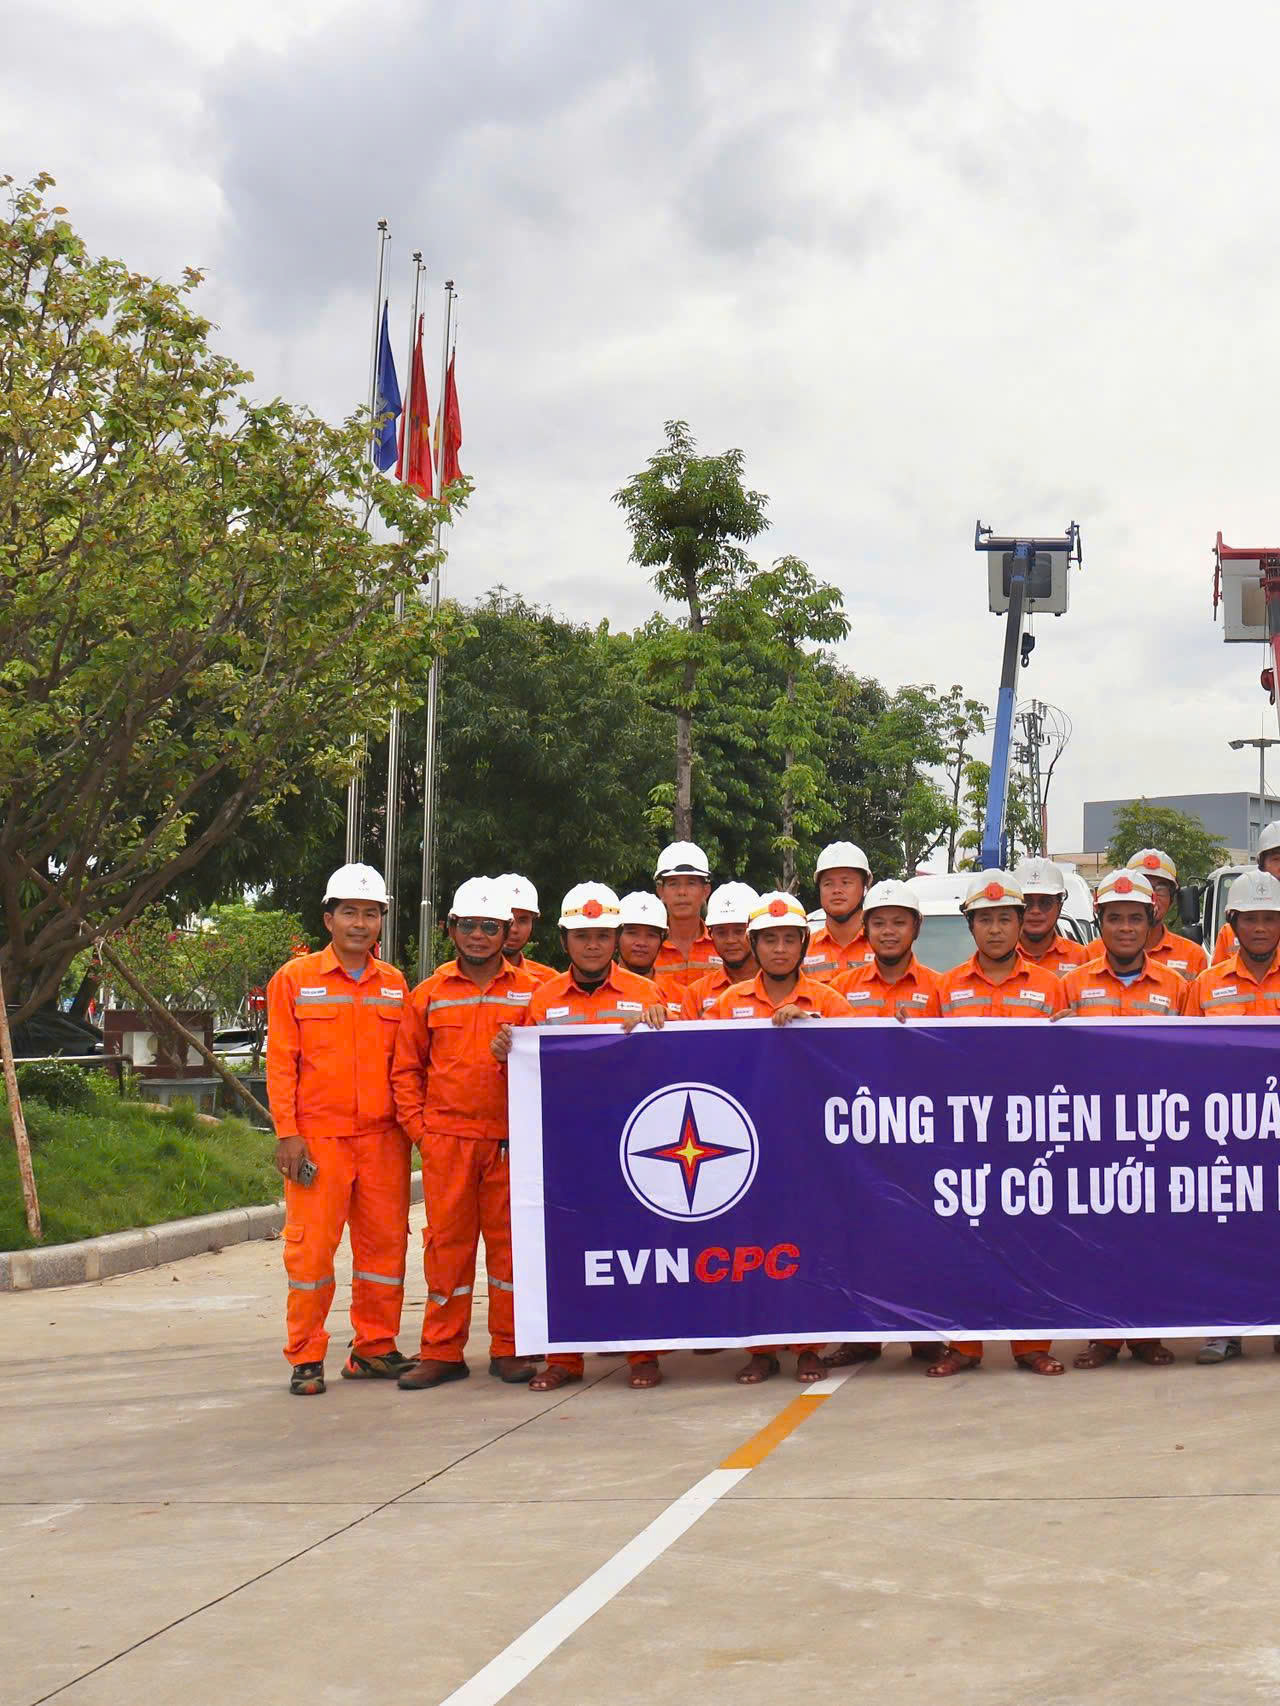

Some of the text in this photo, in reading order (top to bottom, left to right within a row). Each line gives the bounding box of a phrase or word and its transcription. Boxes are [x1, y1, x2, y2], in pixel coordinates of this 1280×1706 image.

[824, 1086, 935, 1145] CÔNG
[947, 1095, 994, 1143] TY
[1005, 1084, 1101, 1152] ĐIỆN
[1115, 1088, 1190, 1152] LỰC
[933, 1163, 992, 1227] SỰ
[1000, 1150, 1055, 1216] CỐ
[1067, 1156, 1156, 1215] LƯỚI
[1168, 1155, 1264, 1223] ĐIỆN
[584, 1243, 800, 1286] EVNCPC
